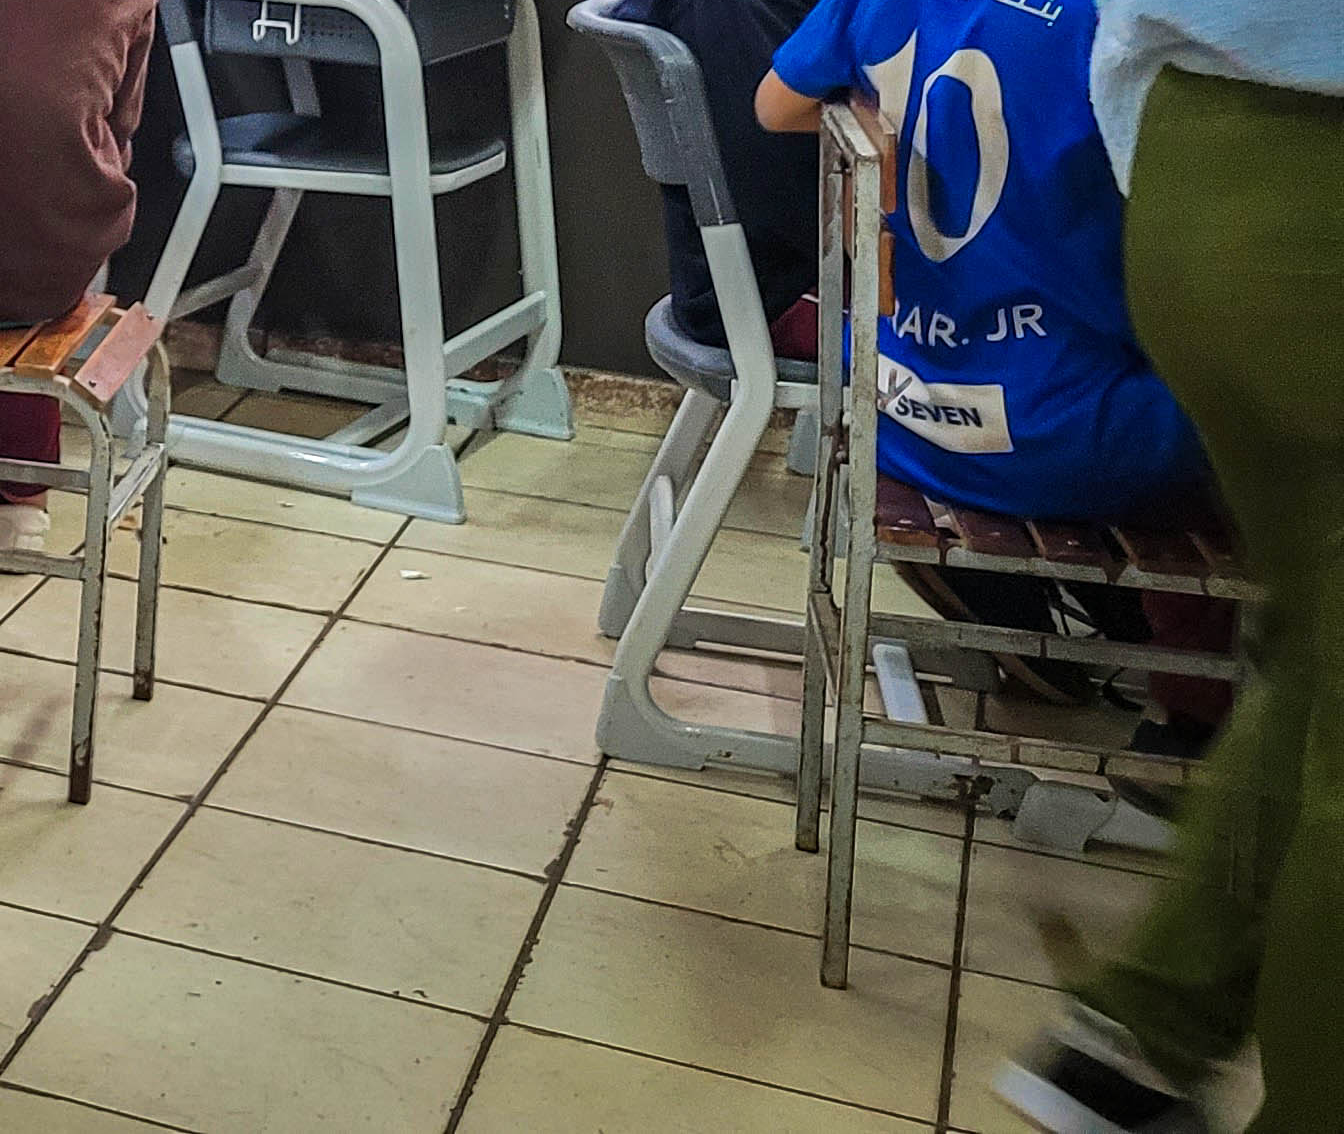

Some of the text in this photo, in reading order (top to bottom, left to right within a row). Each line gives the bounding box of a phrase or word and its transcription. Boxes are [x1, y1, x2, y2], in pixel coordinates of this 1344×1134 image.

[862, 28, 1010, 263] 10
[892, 297, 1047, 348] AR. JR
[894, 394, 983, 429] SEVEN
